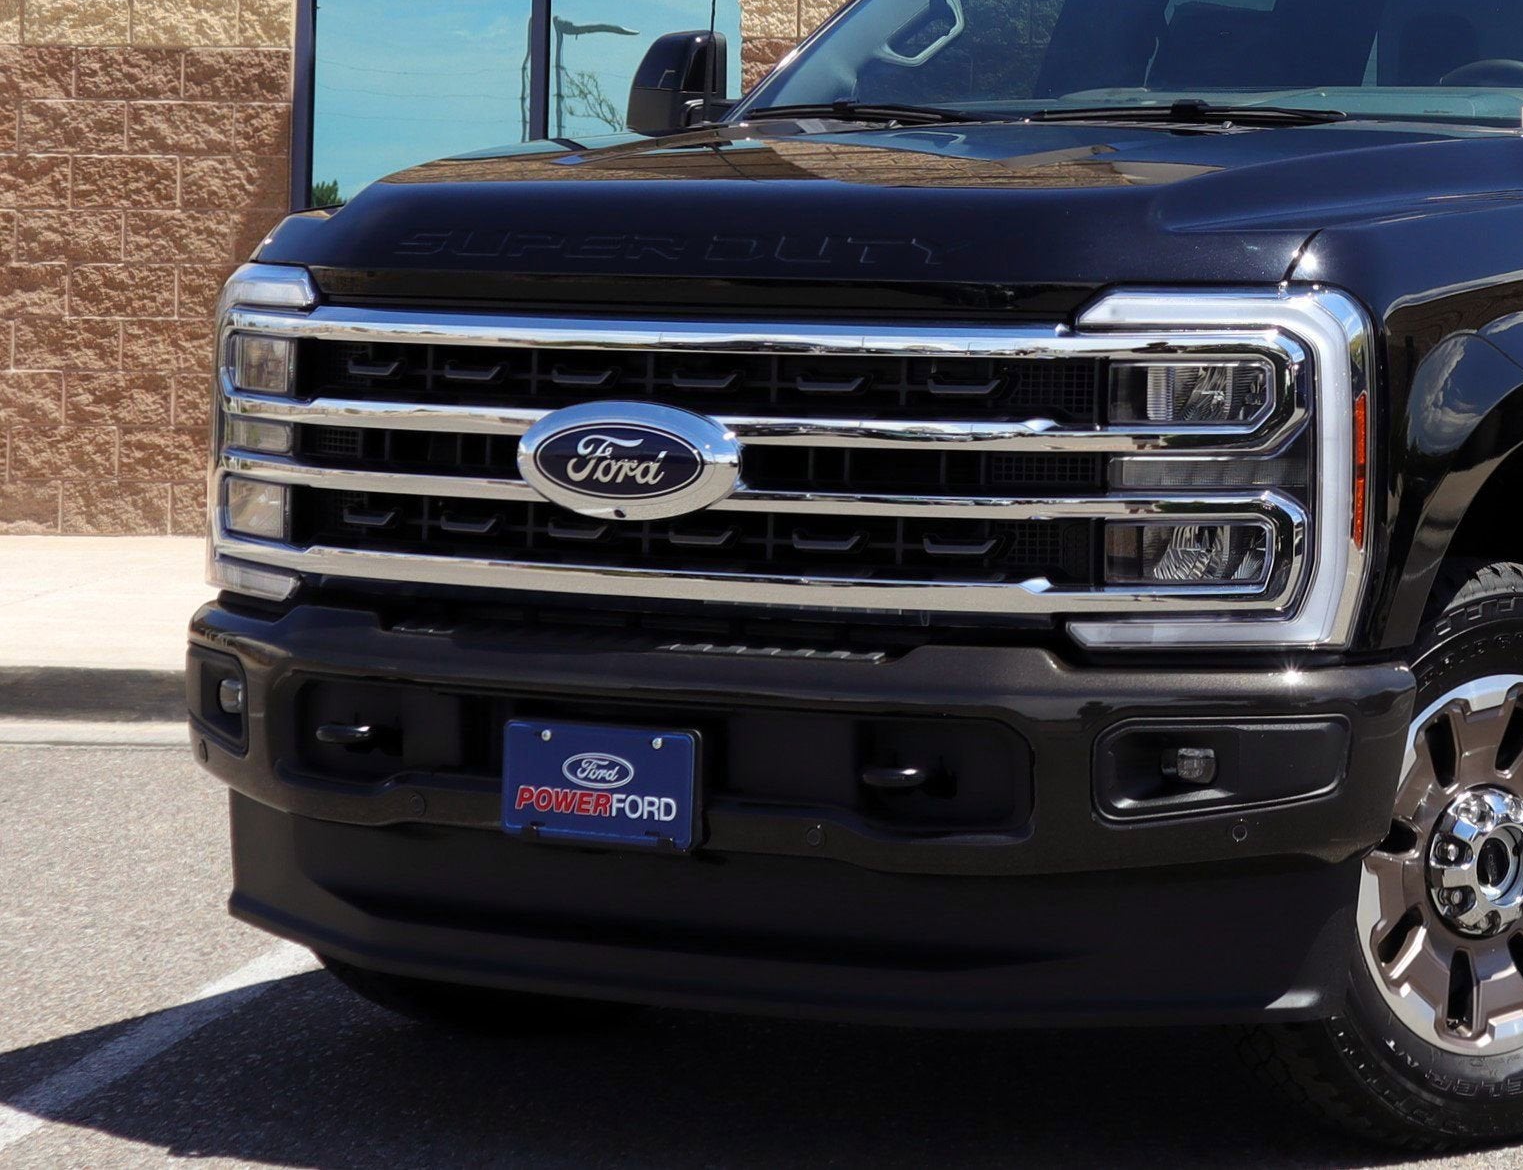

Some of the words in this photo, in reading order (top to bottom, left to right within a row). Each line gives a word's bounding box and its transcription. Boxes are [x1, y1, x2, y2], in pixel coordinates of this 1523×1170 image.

[393, 231, 686, 260] SUPER
[705, 235, 972, 264] DUTY
[566, 434, 668, 485] Ford
[576, 758, 620, 782] Ford
